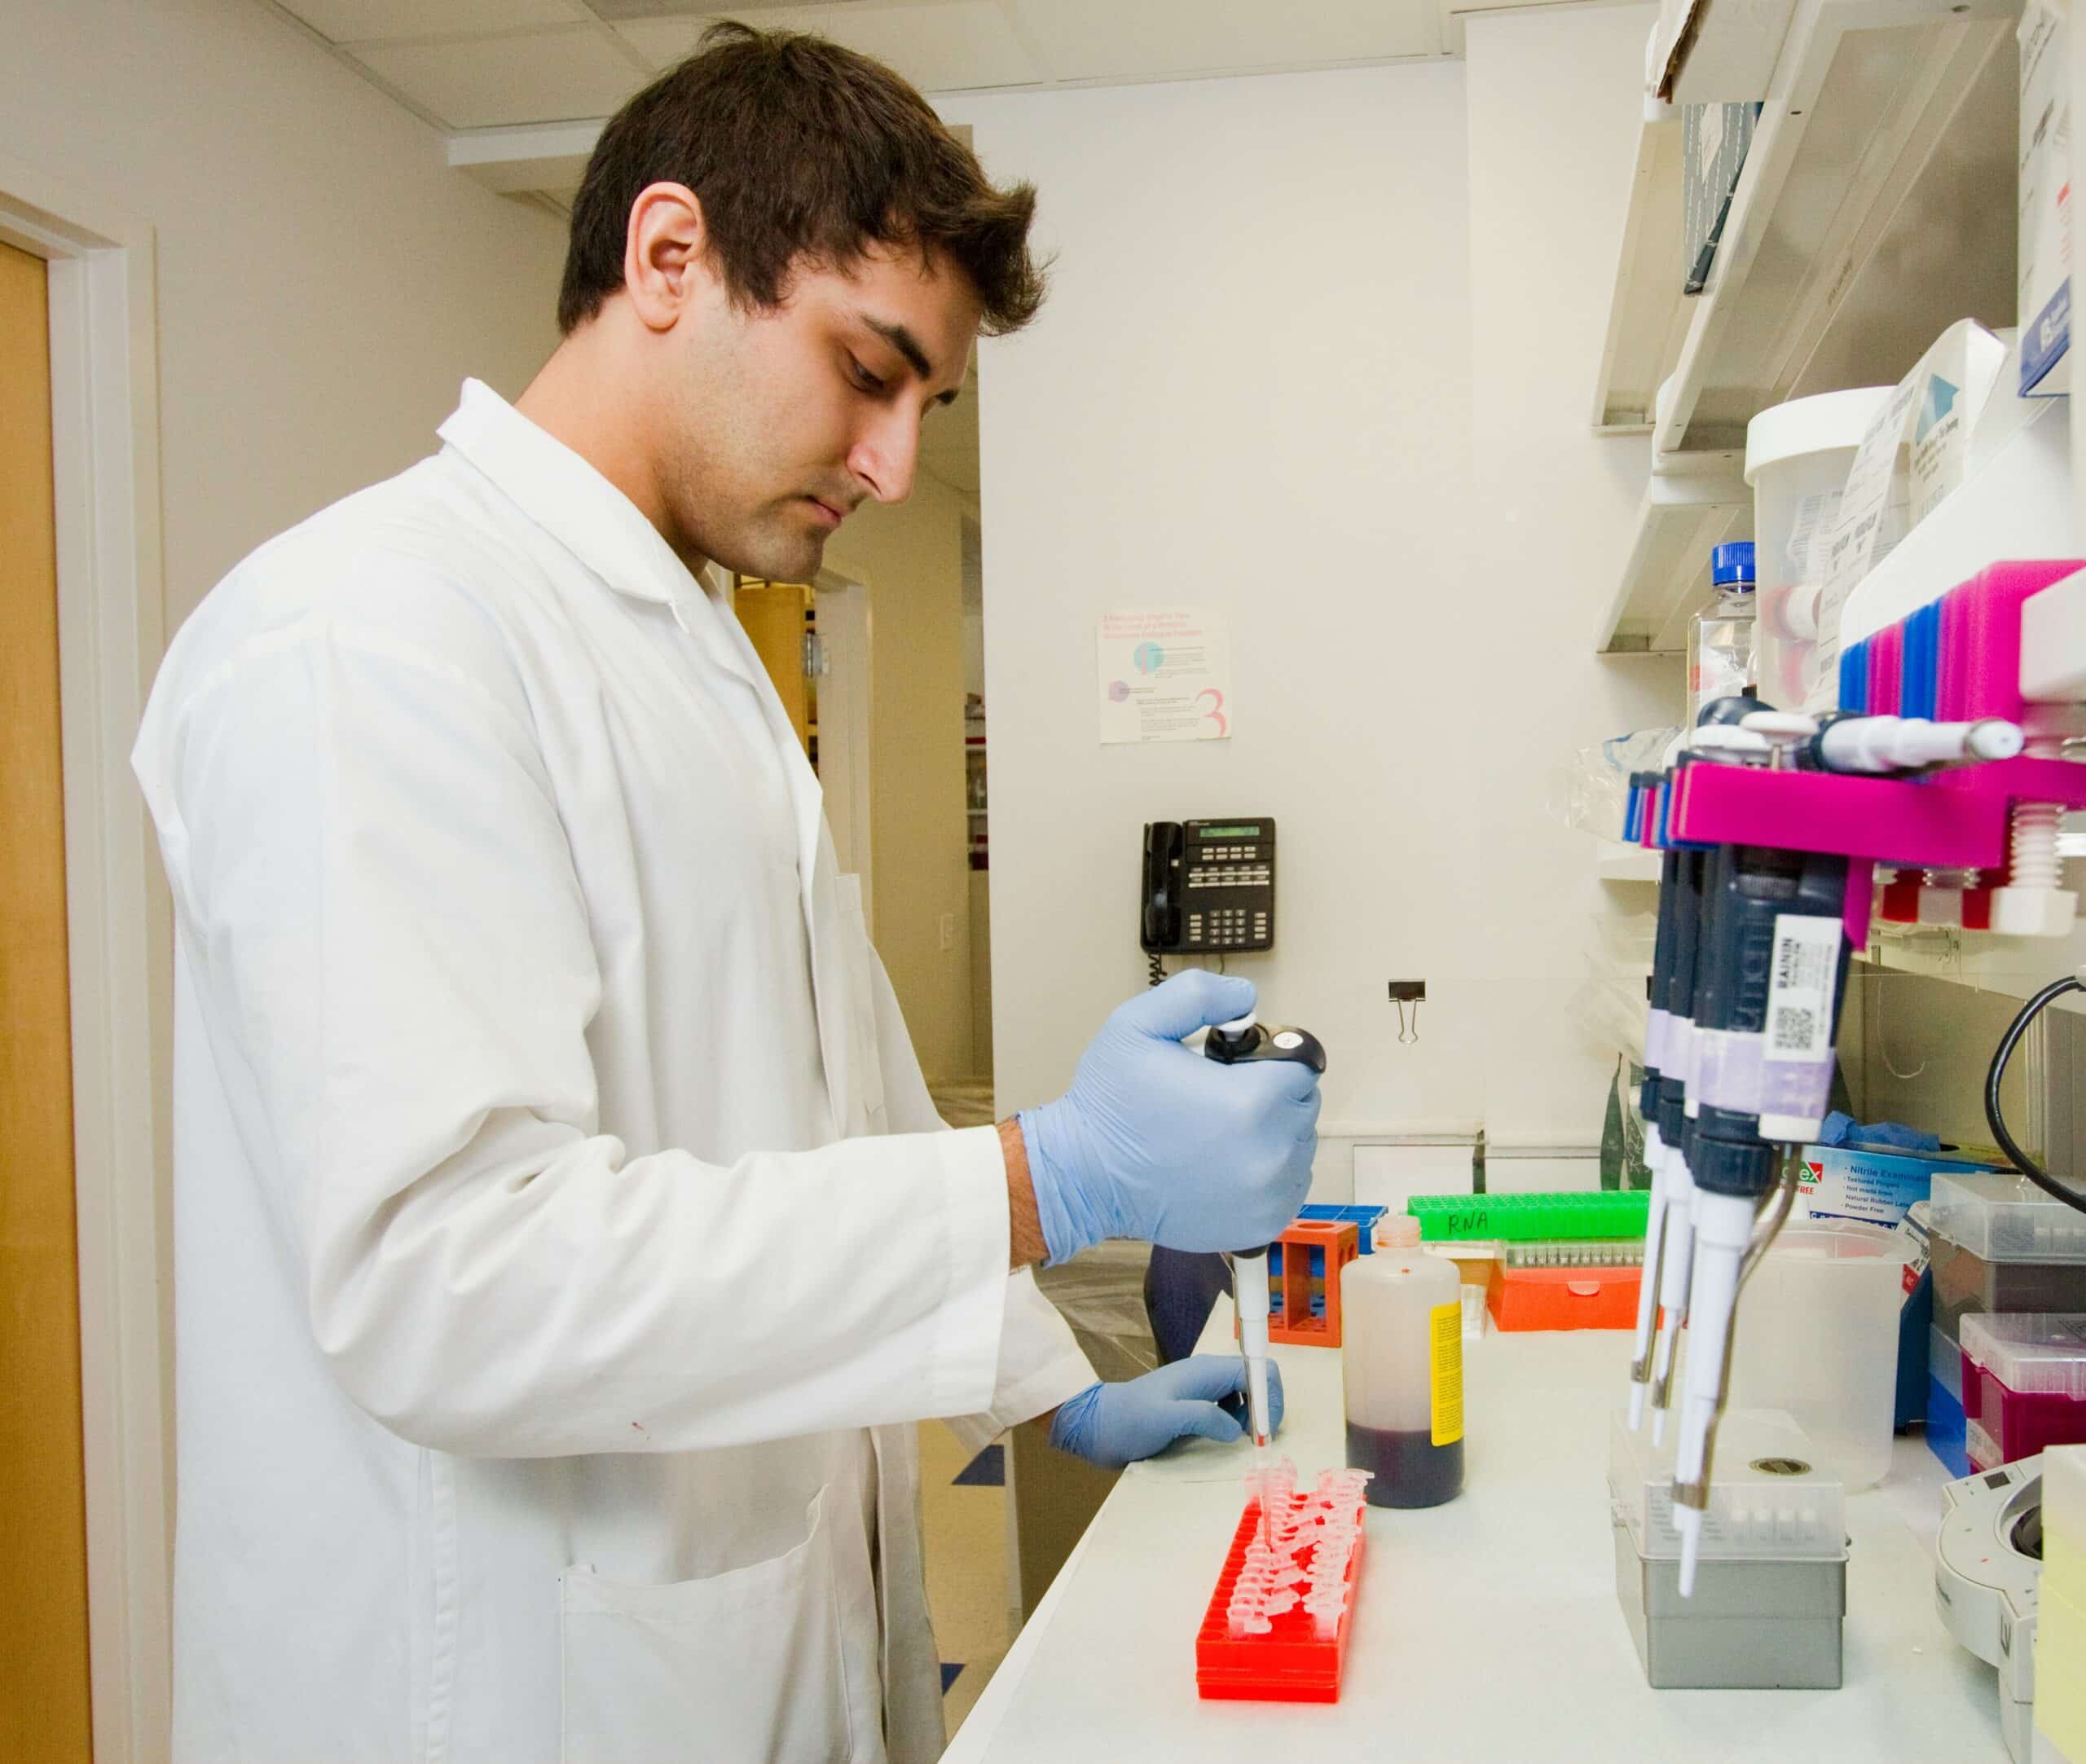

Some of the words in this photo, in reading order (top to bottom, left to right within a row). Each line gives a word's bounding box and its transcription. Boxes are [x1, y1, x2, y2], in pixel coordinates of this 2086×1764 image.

[1851, 1165, 1877, 1177] Nitrile
[1847, 1176, 1874, 1185] Textured
[1799, 1186, 1815, 1194] REE
[1846, 1185, 1858, 1193] Not
[1846, 1194, 1868, 1203] Natural
[1844, 1203, 1868, 1212] Powder
[1448, 1211, 1489, 1235] RNA
